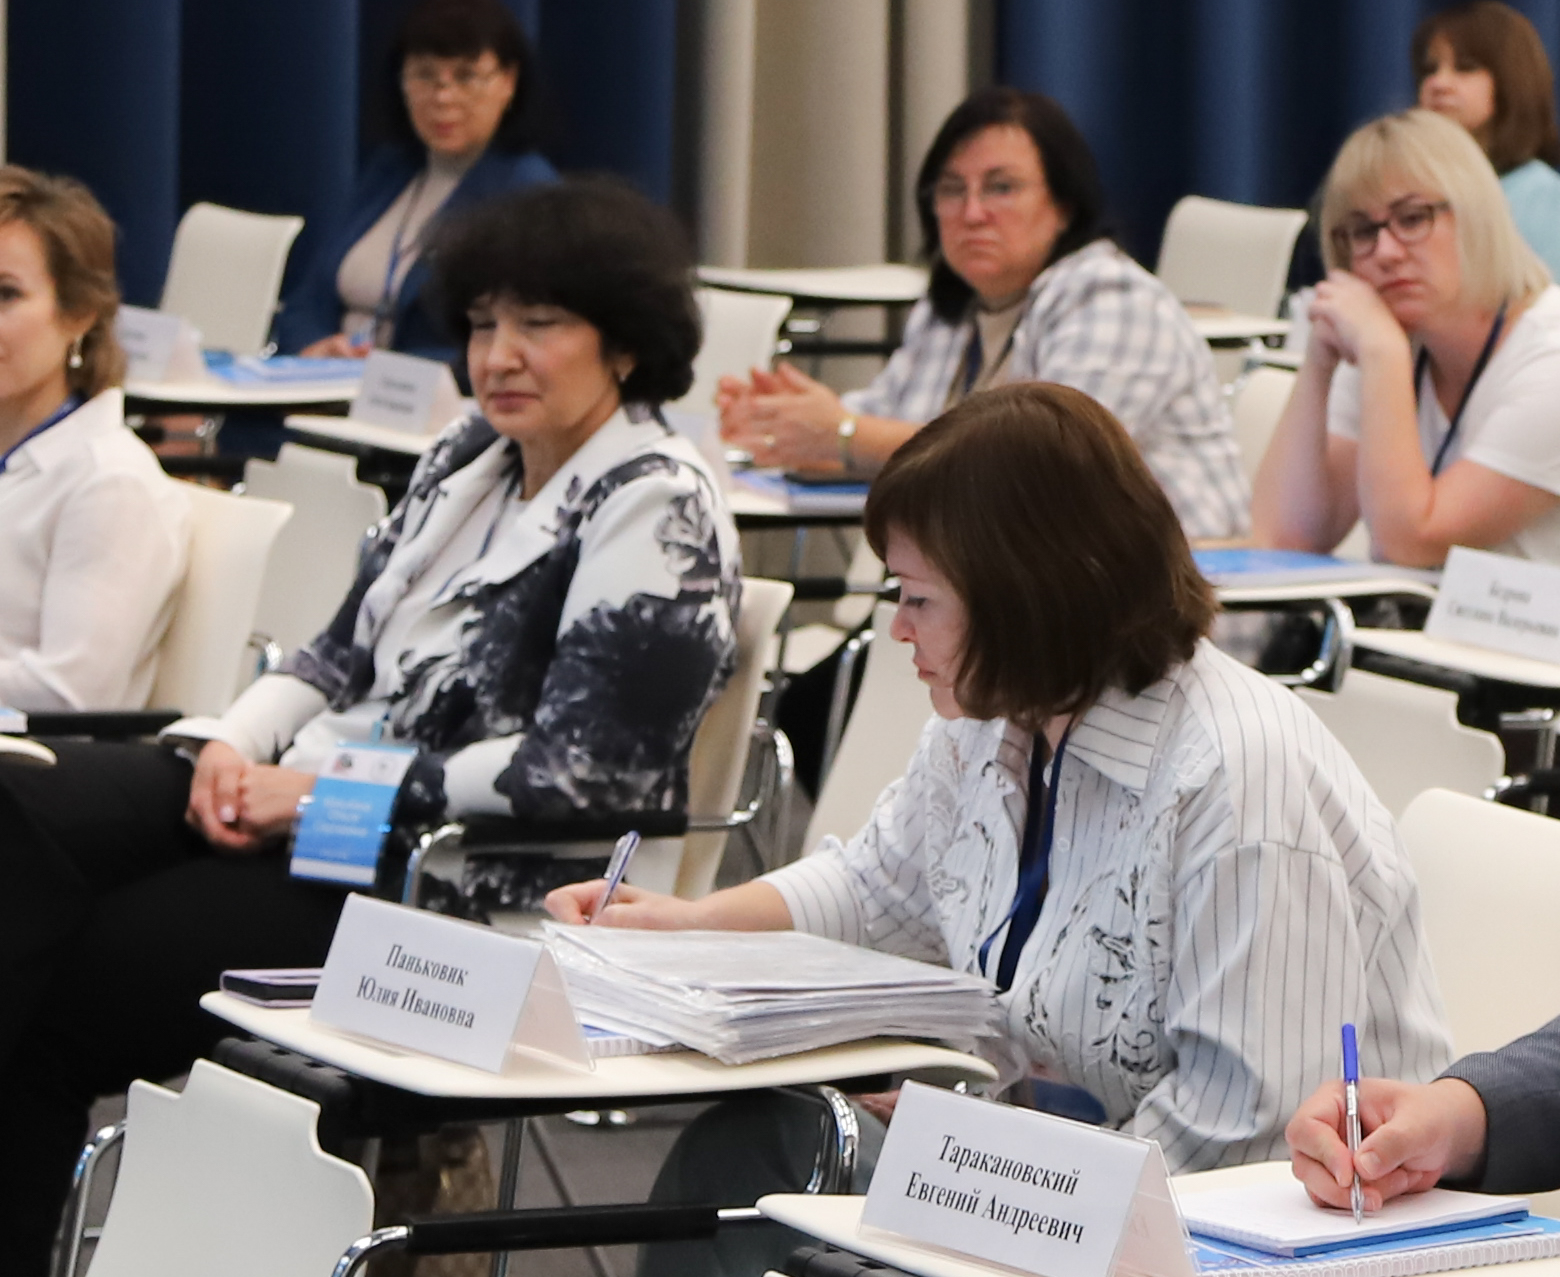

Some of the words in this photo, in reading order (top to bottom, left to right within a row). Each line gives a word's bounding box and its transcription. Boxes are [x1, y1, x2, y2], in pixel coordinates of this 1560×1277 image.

[385, 943, 468, 987] Паньковик
[356, 975, 400, 1008] Юлия
[400, 987, 476, 1030] Ивановна
[939, 1134, 1081, 1197] Таракановский
[905, 1171, 982, 1215] Евгений
[981, 1193, 1085, 1245] Андреевич
